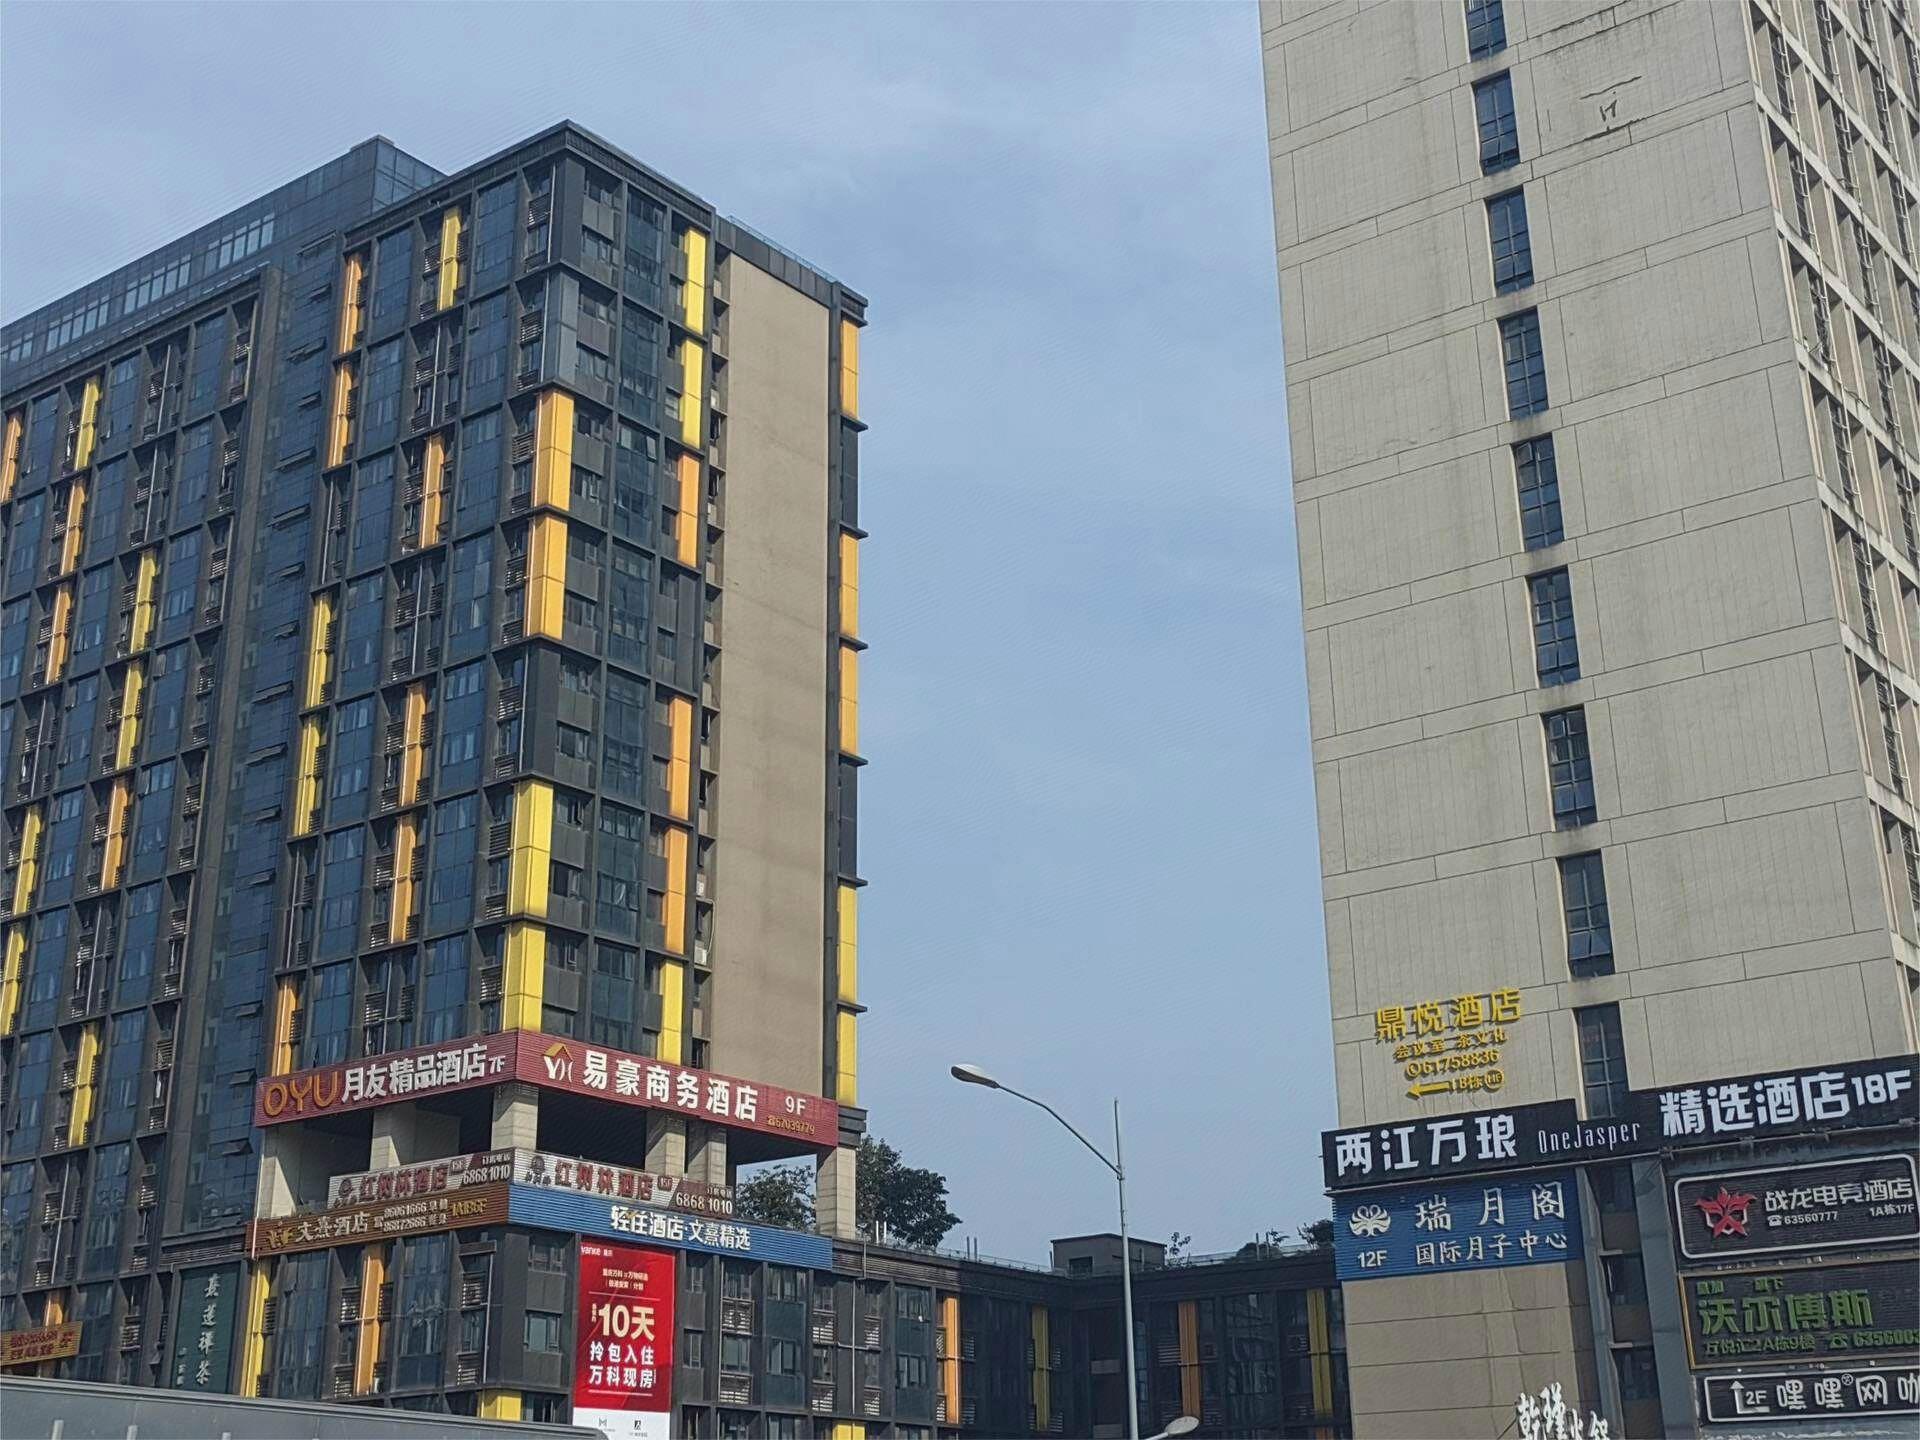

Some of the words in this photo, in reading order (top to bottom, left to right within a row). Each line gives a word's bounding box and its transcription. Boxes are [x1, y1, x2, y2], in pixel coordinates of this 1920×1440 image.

[1376, 988, 1521, 1041] 鼎悦酒店
[263, 1070, 342, 1117] OYU
[342, 1044, 487, 1103] 月友精品酒店
[489, 1055, 506, 1074] 7F
[582, 1049, 758, 1122] 易豪商务酒店
[785, 1096, 806, 1115] 9F
[1659, 1072, 1850, 1137] 精选酒店
[1851, 1070, 1912, 1106] 18F
[1336, 1114, 1517, 1176] 两江万琅
[1538, 1122, 1640, 1154] OneJasper
[555, 1160, 653, 1201] 红树林酒店
[1765, 1178, 1913, 1212] 战龙电竞酒店
[1415, 1181, 1566, 1233] 瑞月阁
[1784, 1210, 1838, 1225] 63560777
[1869, 1203, 1915, 1218] 1A栋17F
[1358, 1251, 1387, 1269] 12F
[1416, 1230, 1568, 1266] 国际月子中心
[599, 1303, 655, 1342] 10天
[1699, 1289, 1873, 1335] 沃尔博斯
[590, 1341, 654, 1366] 拎包入住
[589, 1365, 653, 1389] 万科现房
[1746, 1390, 1767, 1405] 2F
